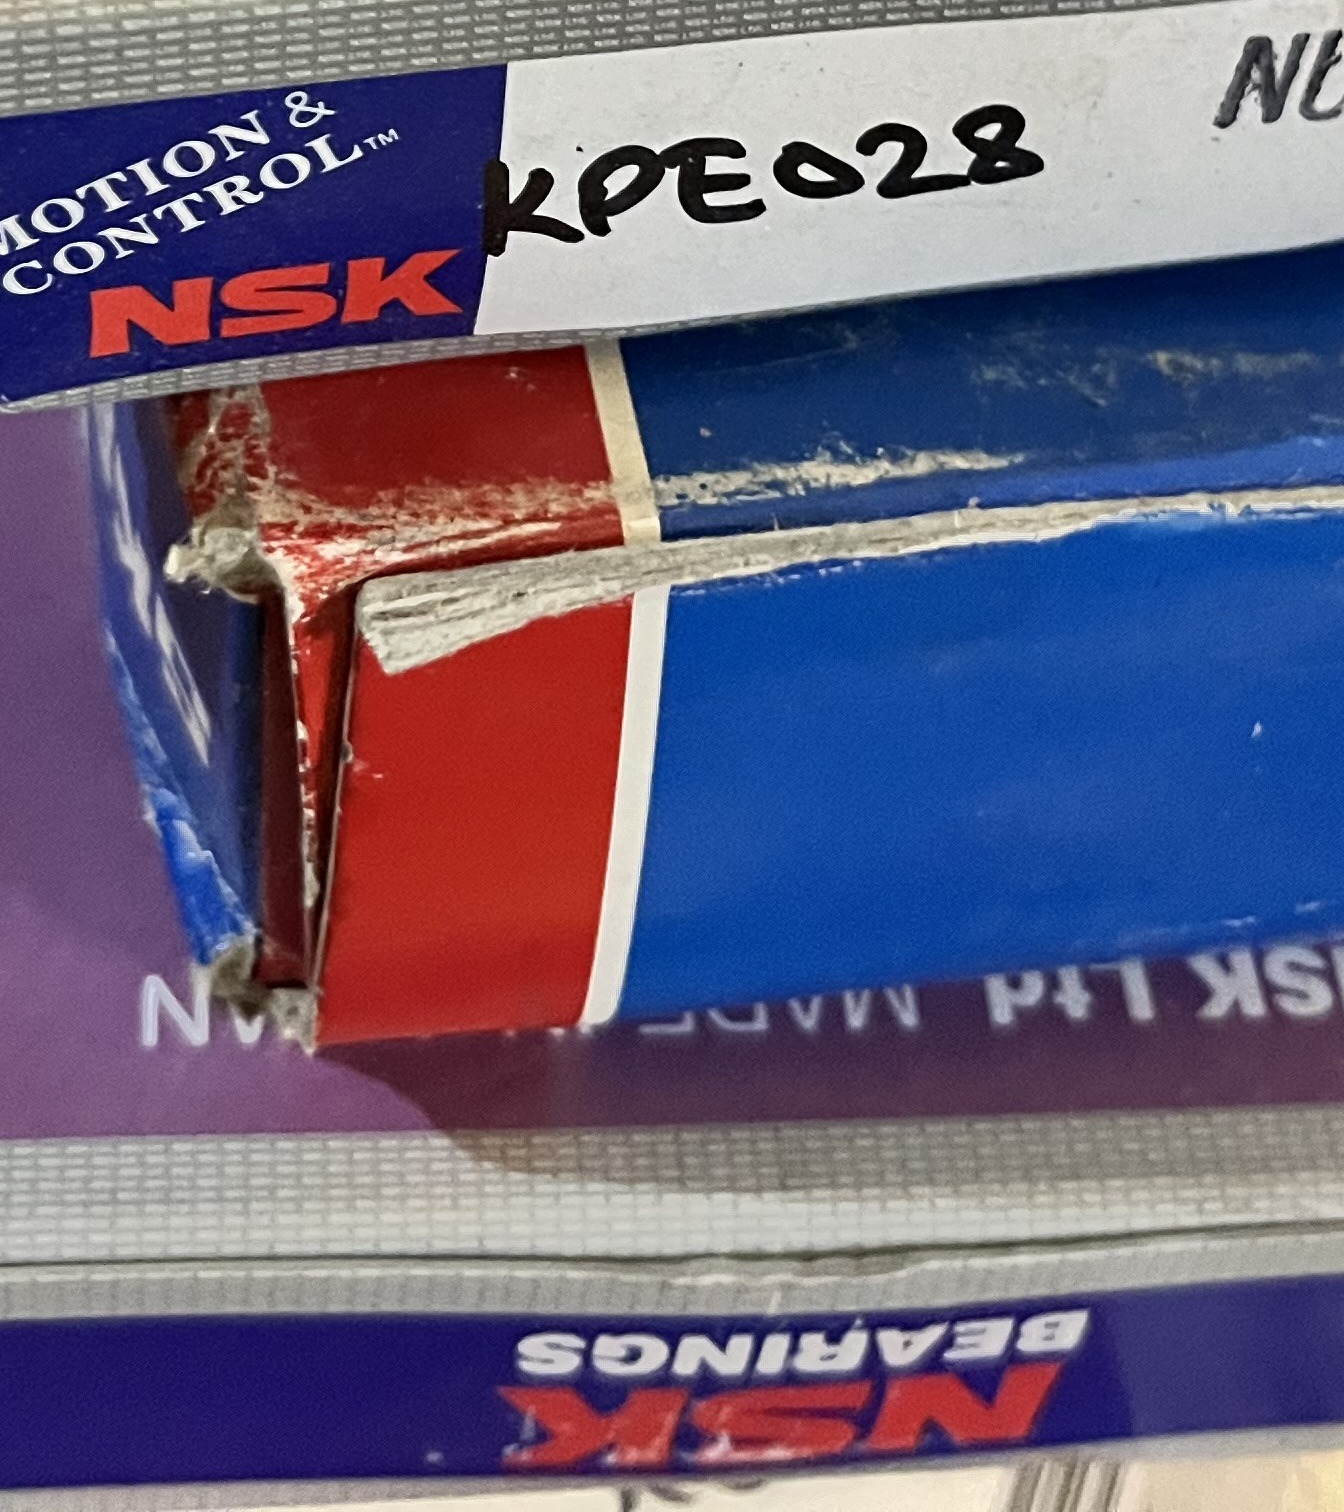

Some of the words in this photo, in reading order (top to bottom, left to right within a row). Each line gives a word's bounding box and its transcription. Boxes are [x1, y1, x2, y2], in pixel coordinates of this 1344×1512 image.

[284, 90, 336, 129] &
[481, 103, 1045, 258] KPE028
[88, 248, 465, 340] NSK
[516, 1308, 1090, 1378] BEARINGS
[498, 1362, 1064, 1469] NSK
